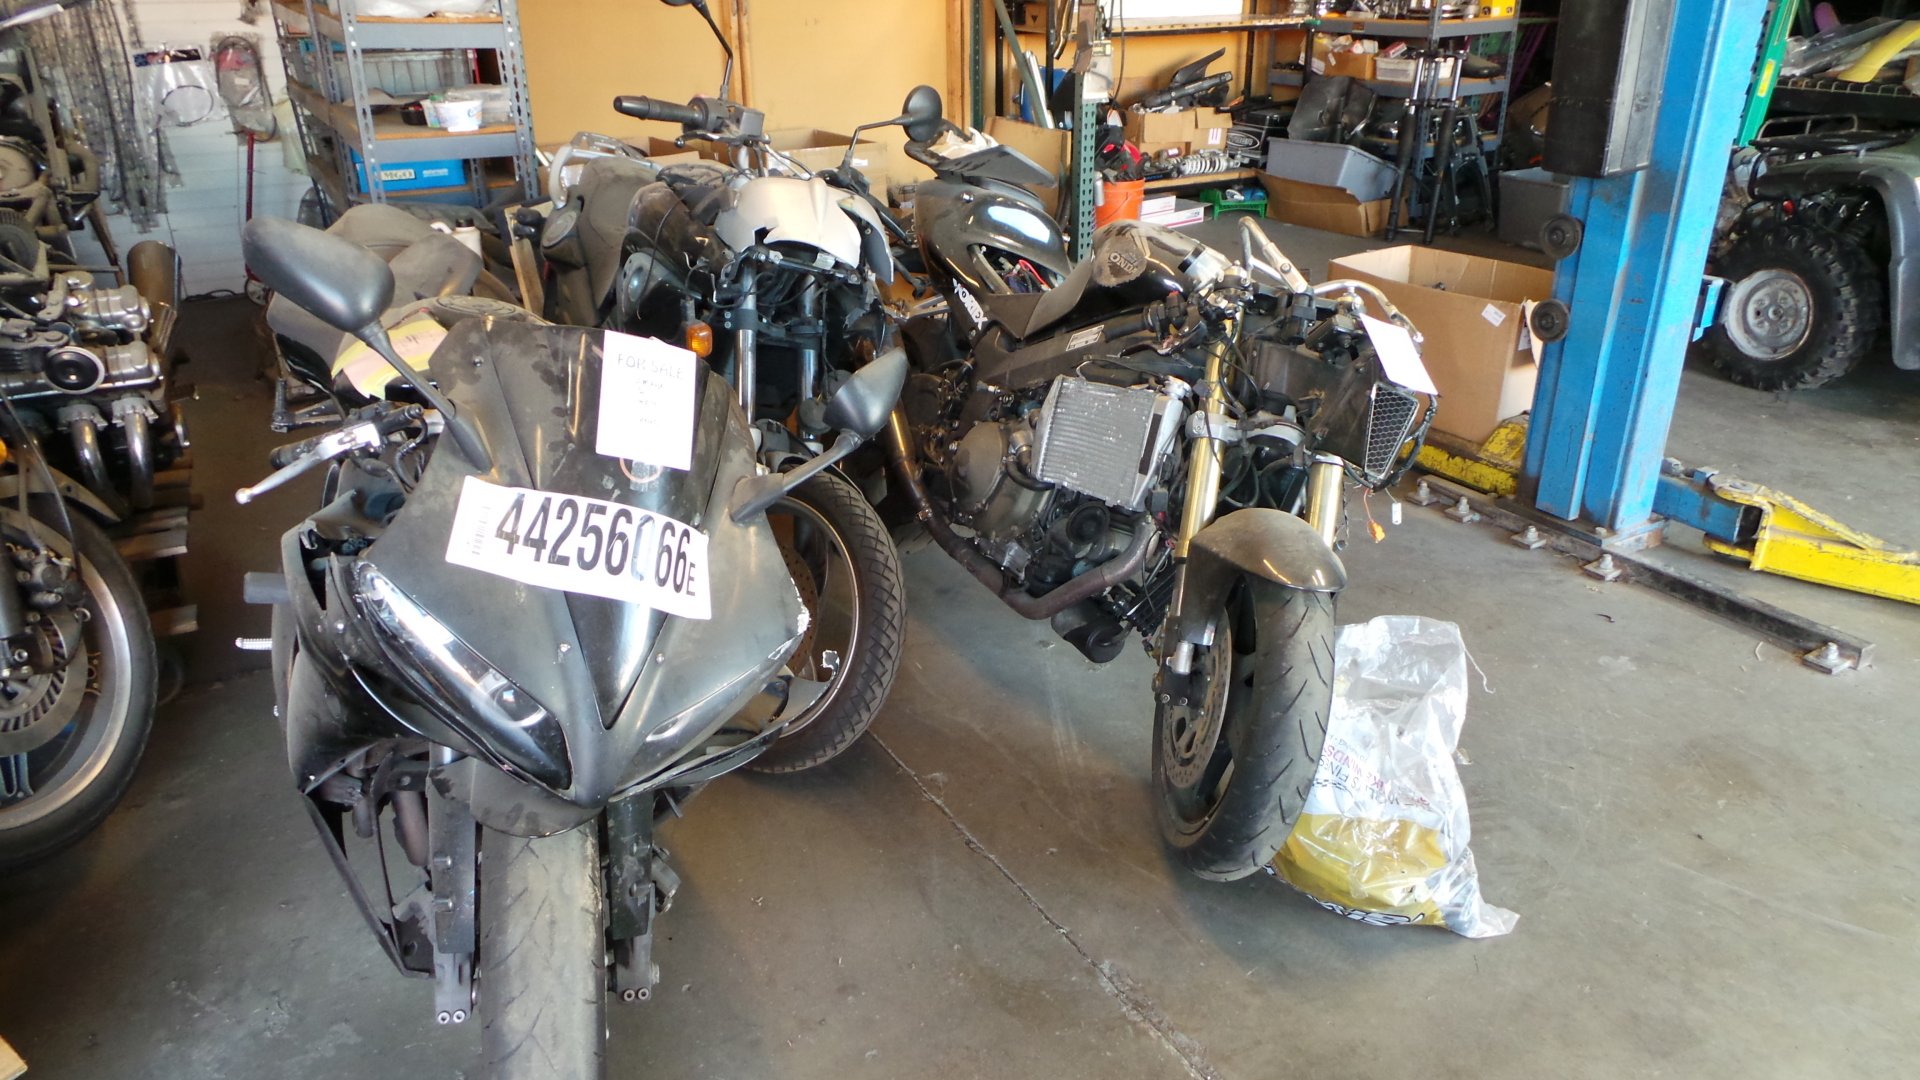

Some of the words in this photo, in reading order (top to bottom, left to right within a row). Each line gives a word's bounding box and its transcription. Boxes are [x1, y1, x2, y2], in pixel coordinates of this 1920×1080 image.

[952, 278, 988, 330] VORTEX
[617, 353, 646, 370] FOR
[651, 360, 684, 379] SALE
